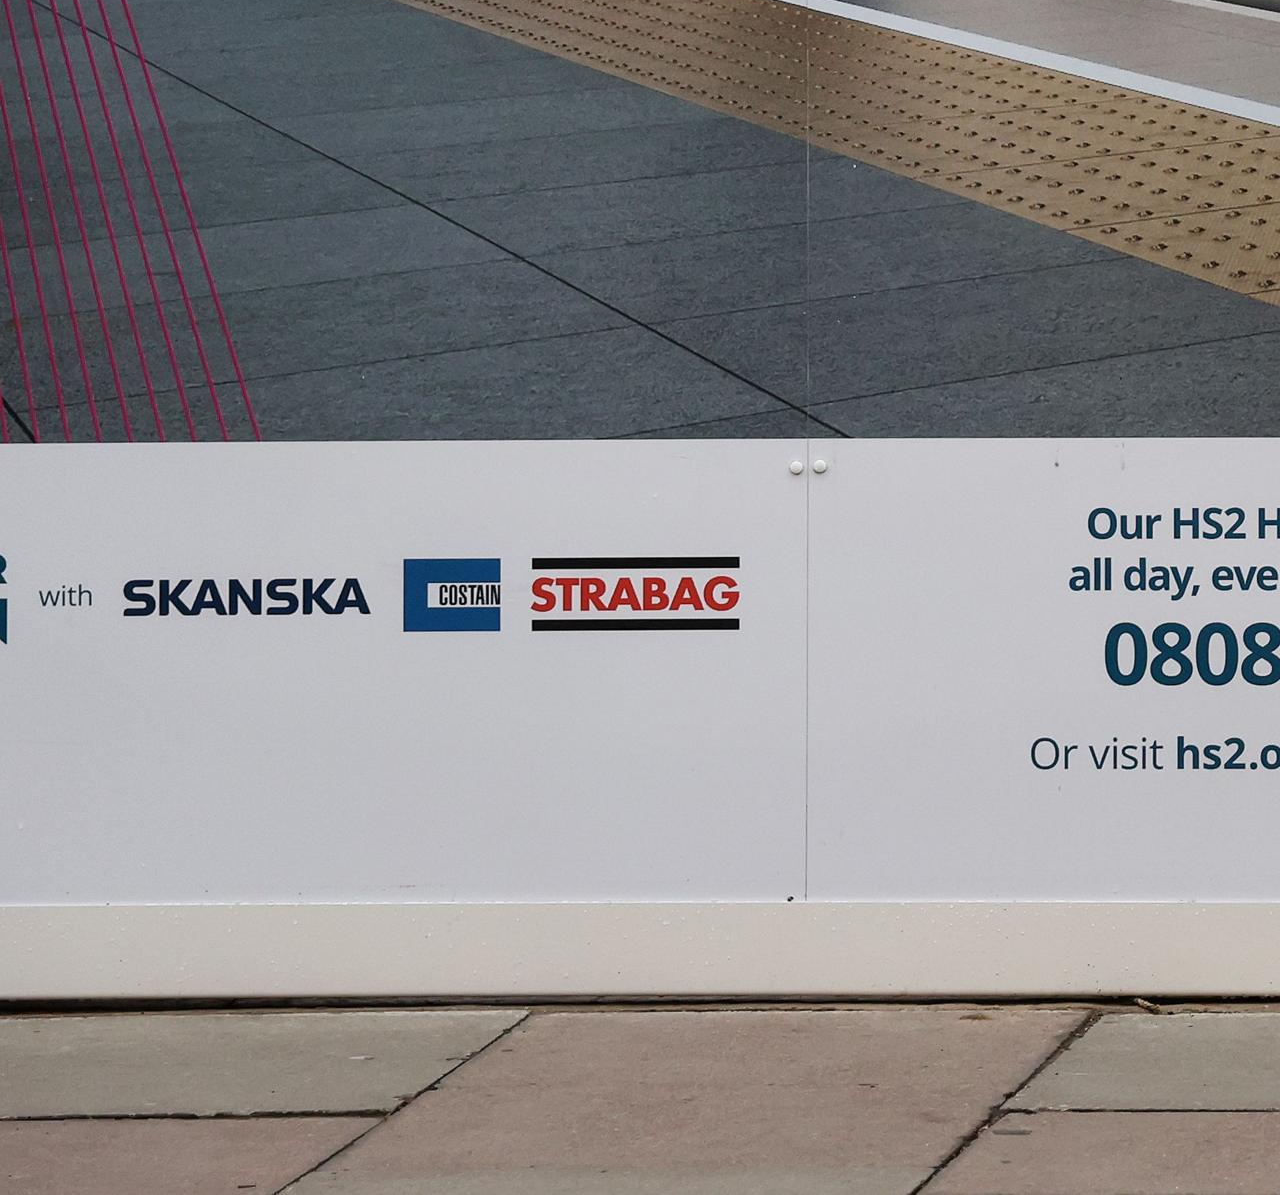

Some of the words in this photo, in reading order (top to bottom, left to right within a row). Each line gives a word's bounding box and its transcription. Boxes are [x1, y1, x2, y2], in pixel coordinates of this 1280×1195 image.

[1087, 507, 1162, 540] Our
[1173, 507, 1246, 540] HS2
[39, 584, 92, 606] with
[439, 584, 500, 605] COSTAIN
[530, 575, 740, 612] STRABAG
[1069, 557, 1111, 592] all
[1124, 557, 1200, 601] day,
[123, 578, 371, 616] SKANSKA
[1030, 737, 1078, 771] Or
[1089, 737, 1163, 771] visit
